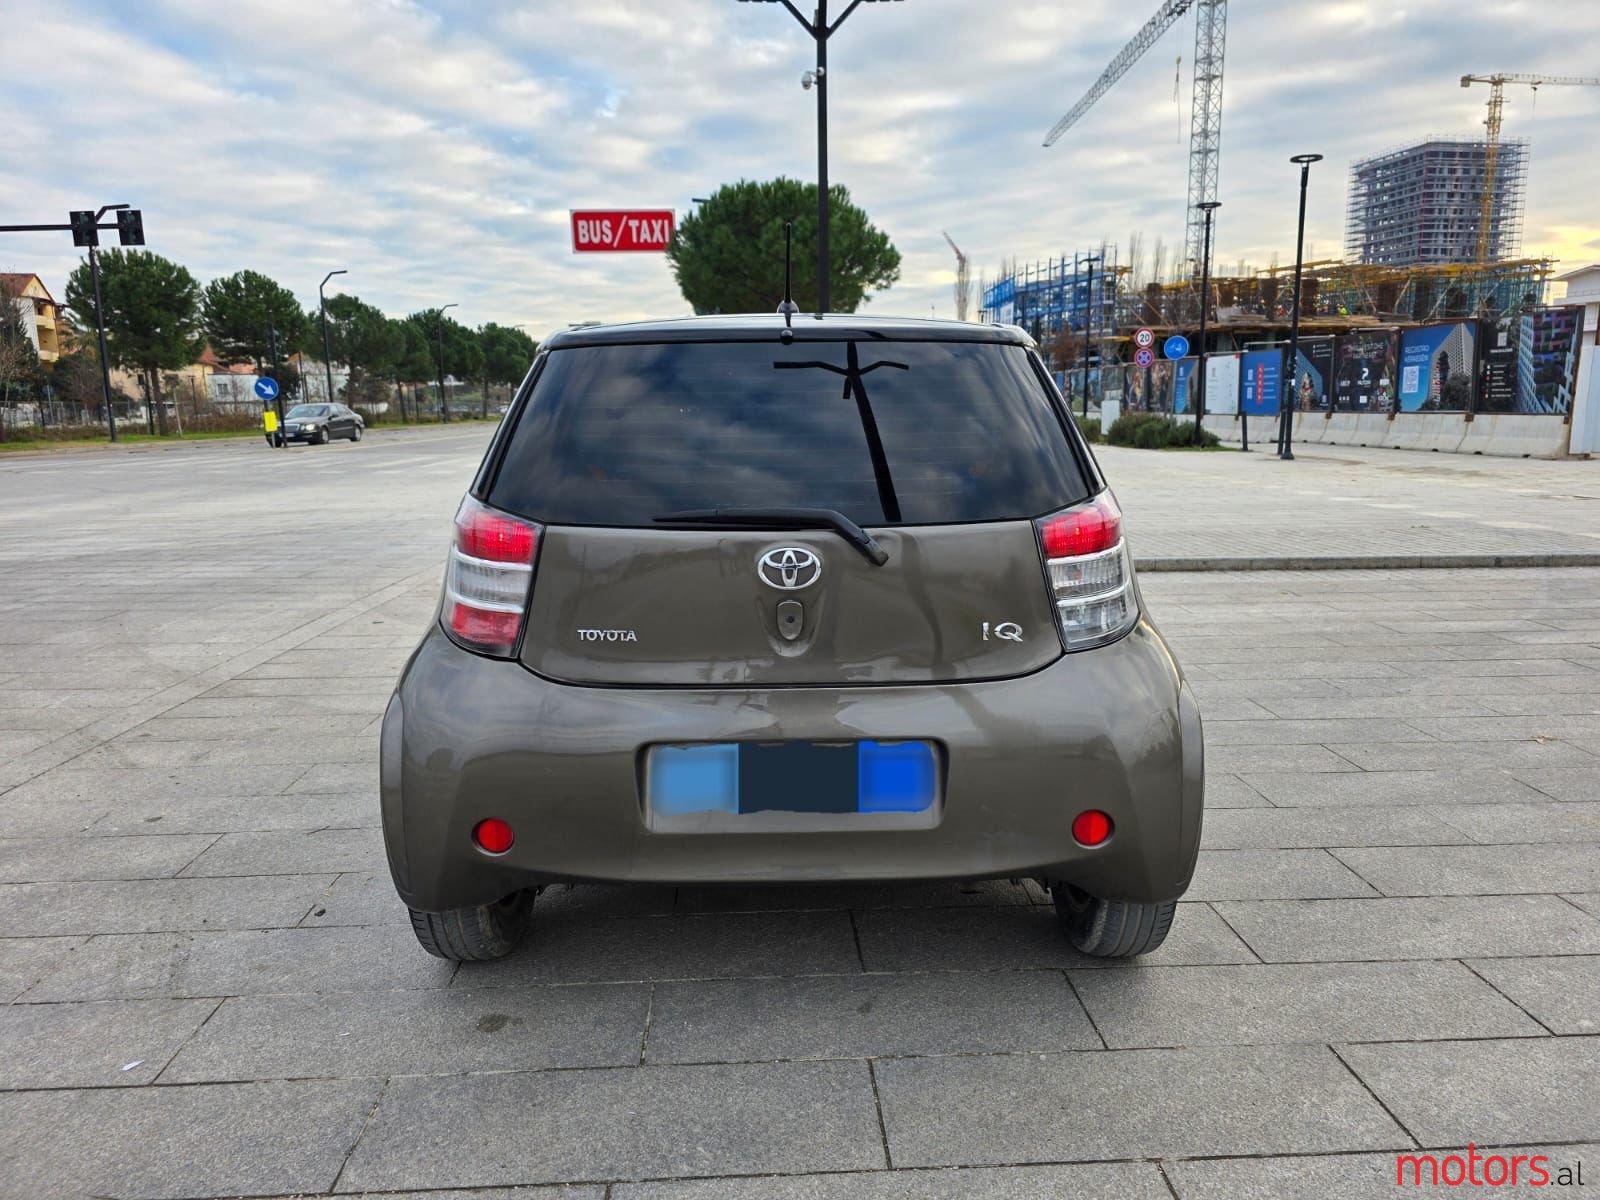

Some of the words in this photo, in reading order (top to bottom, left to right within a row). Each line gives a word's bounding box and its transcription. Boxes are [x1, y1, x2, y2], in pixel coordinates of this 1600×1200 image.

[577, 215, 670, 248] BUS/TAXI
[1139, 333, 1150, 343] 20
[577, 629, 638, 642] TOYOTA
